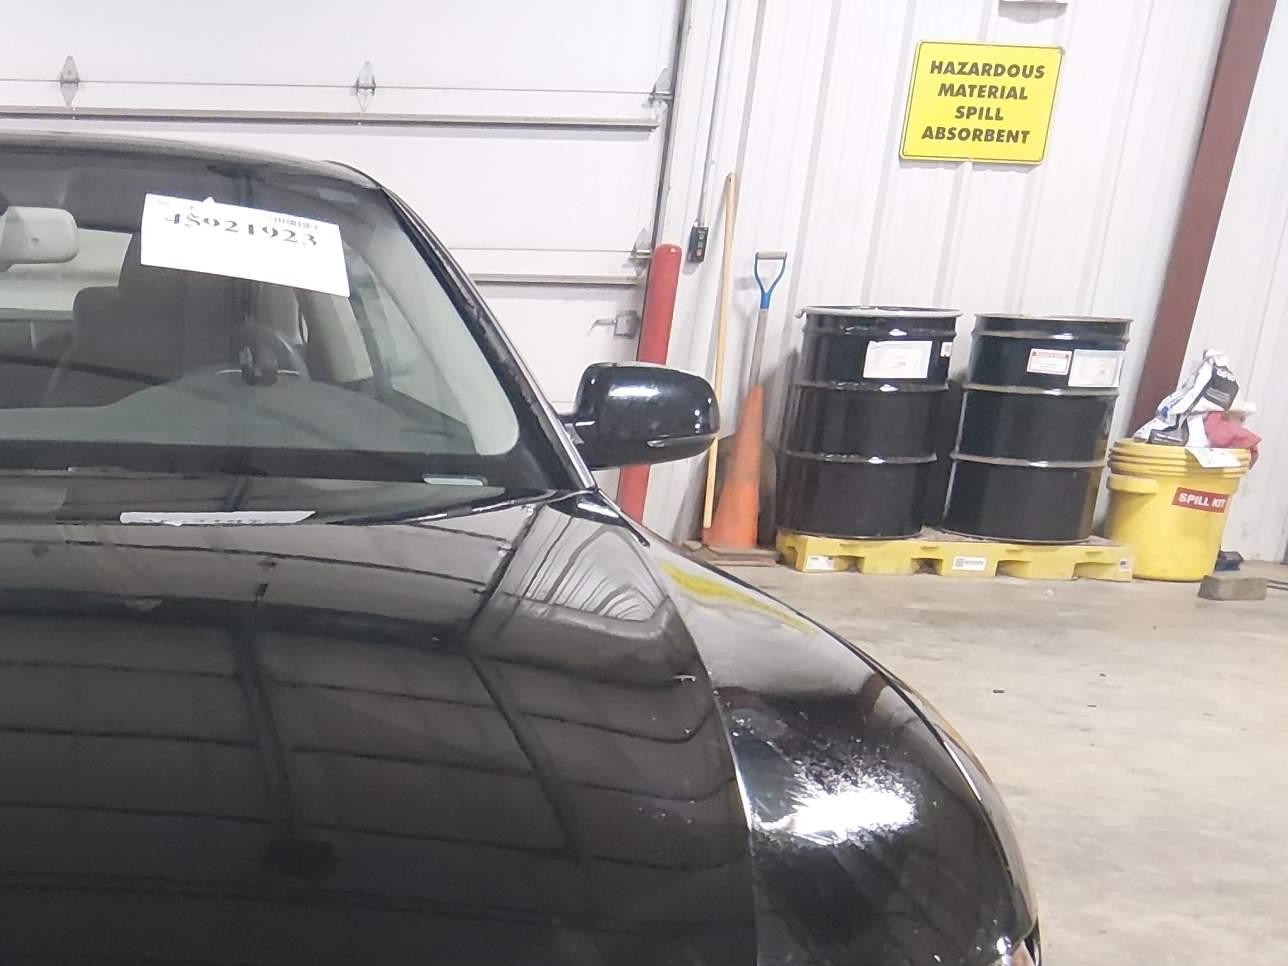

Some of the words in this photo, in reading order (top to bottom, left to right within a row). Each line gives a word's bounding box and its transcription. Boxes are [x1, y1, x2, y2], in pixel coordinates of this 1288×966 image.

[929, 60, 1045, 79] HAZARDOUS
[937, 83, 1028, 100] MATERIAL
[954, 105, 1004, 121] SPILL
[921, 126, 1030, 144] ABSORBENT
[1178, 493, 1210, 507] SPILL
[1211, 498, 1226, 508] KIT
